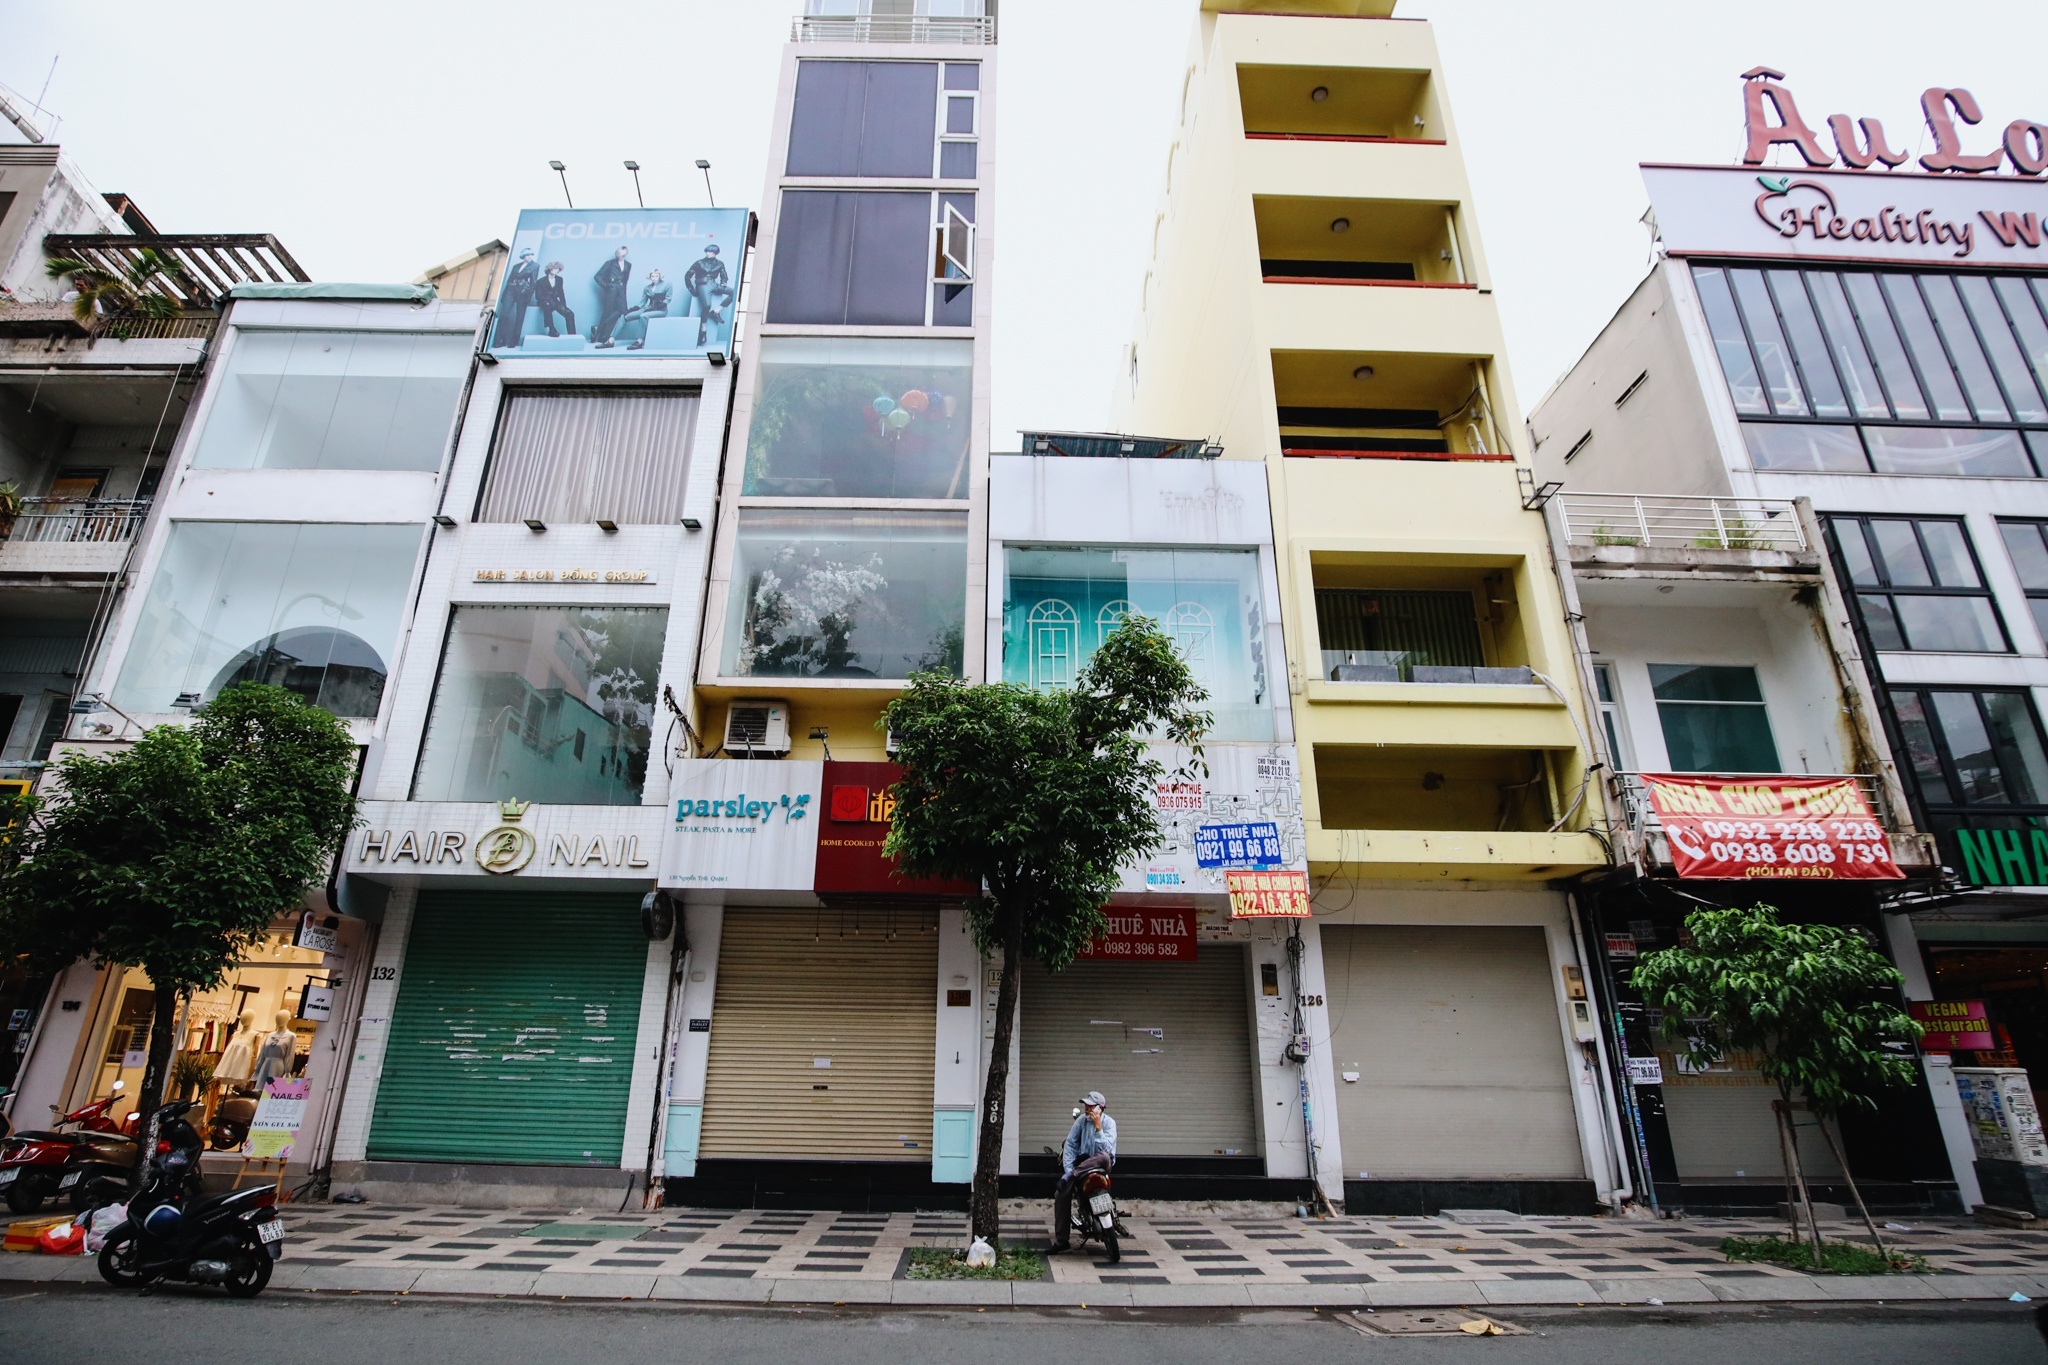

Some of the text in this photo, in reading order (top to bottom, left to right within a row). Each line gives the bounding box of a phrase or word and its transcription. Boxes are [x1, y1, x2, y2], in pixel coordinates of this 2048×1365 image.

[1740, 65, 1910, 170] Âu
[1781, 204, 1975, 257] Healthy
[476, 569, 506, 580] HAIR
[512, 569, 554, 581] SALON
[604, 570, 648, 581] GROUP
[1157, 796, 1202, 809] 0936 075 915
[1652, 779, 1867, 815] NHÀ CHO THUÊ
[676, 794, 777, 824] parsley
[703, 826, 725, 834] PASTA
[1196, 824, 1276, 841] CHO THUÊ NHÀ
[1702, 821, 1882, 841] 0932 228 228
[358, 829, 649, 867] HAIR NAIL
[843, 839, 875, 847] COOKED
[1197, 838, 1279, 861] 0921 99 66 88
[1711, 841, 1890, 864] 0938 608 739
[1228, 875, 1241, 891] CHO
[1230, 892, 1308, 915] 0922.16.36.36
[1150, 913, 1188, 937] NHÀ
[1104, 941, 1131, 955] 0982
[1134, 942, 1155, 955] 396
[1158, 943, 1178, 956] 582
[371, 966, 396, 981] 132
[1300, 994, 1323, 1007] 126
[1924, 1002, 1969, 1017] VEGAN
[271, 1092, 303, 1100] NAILS
